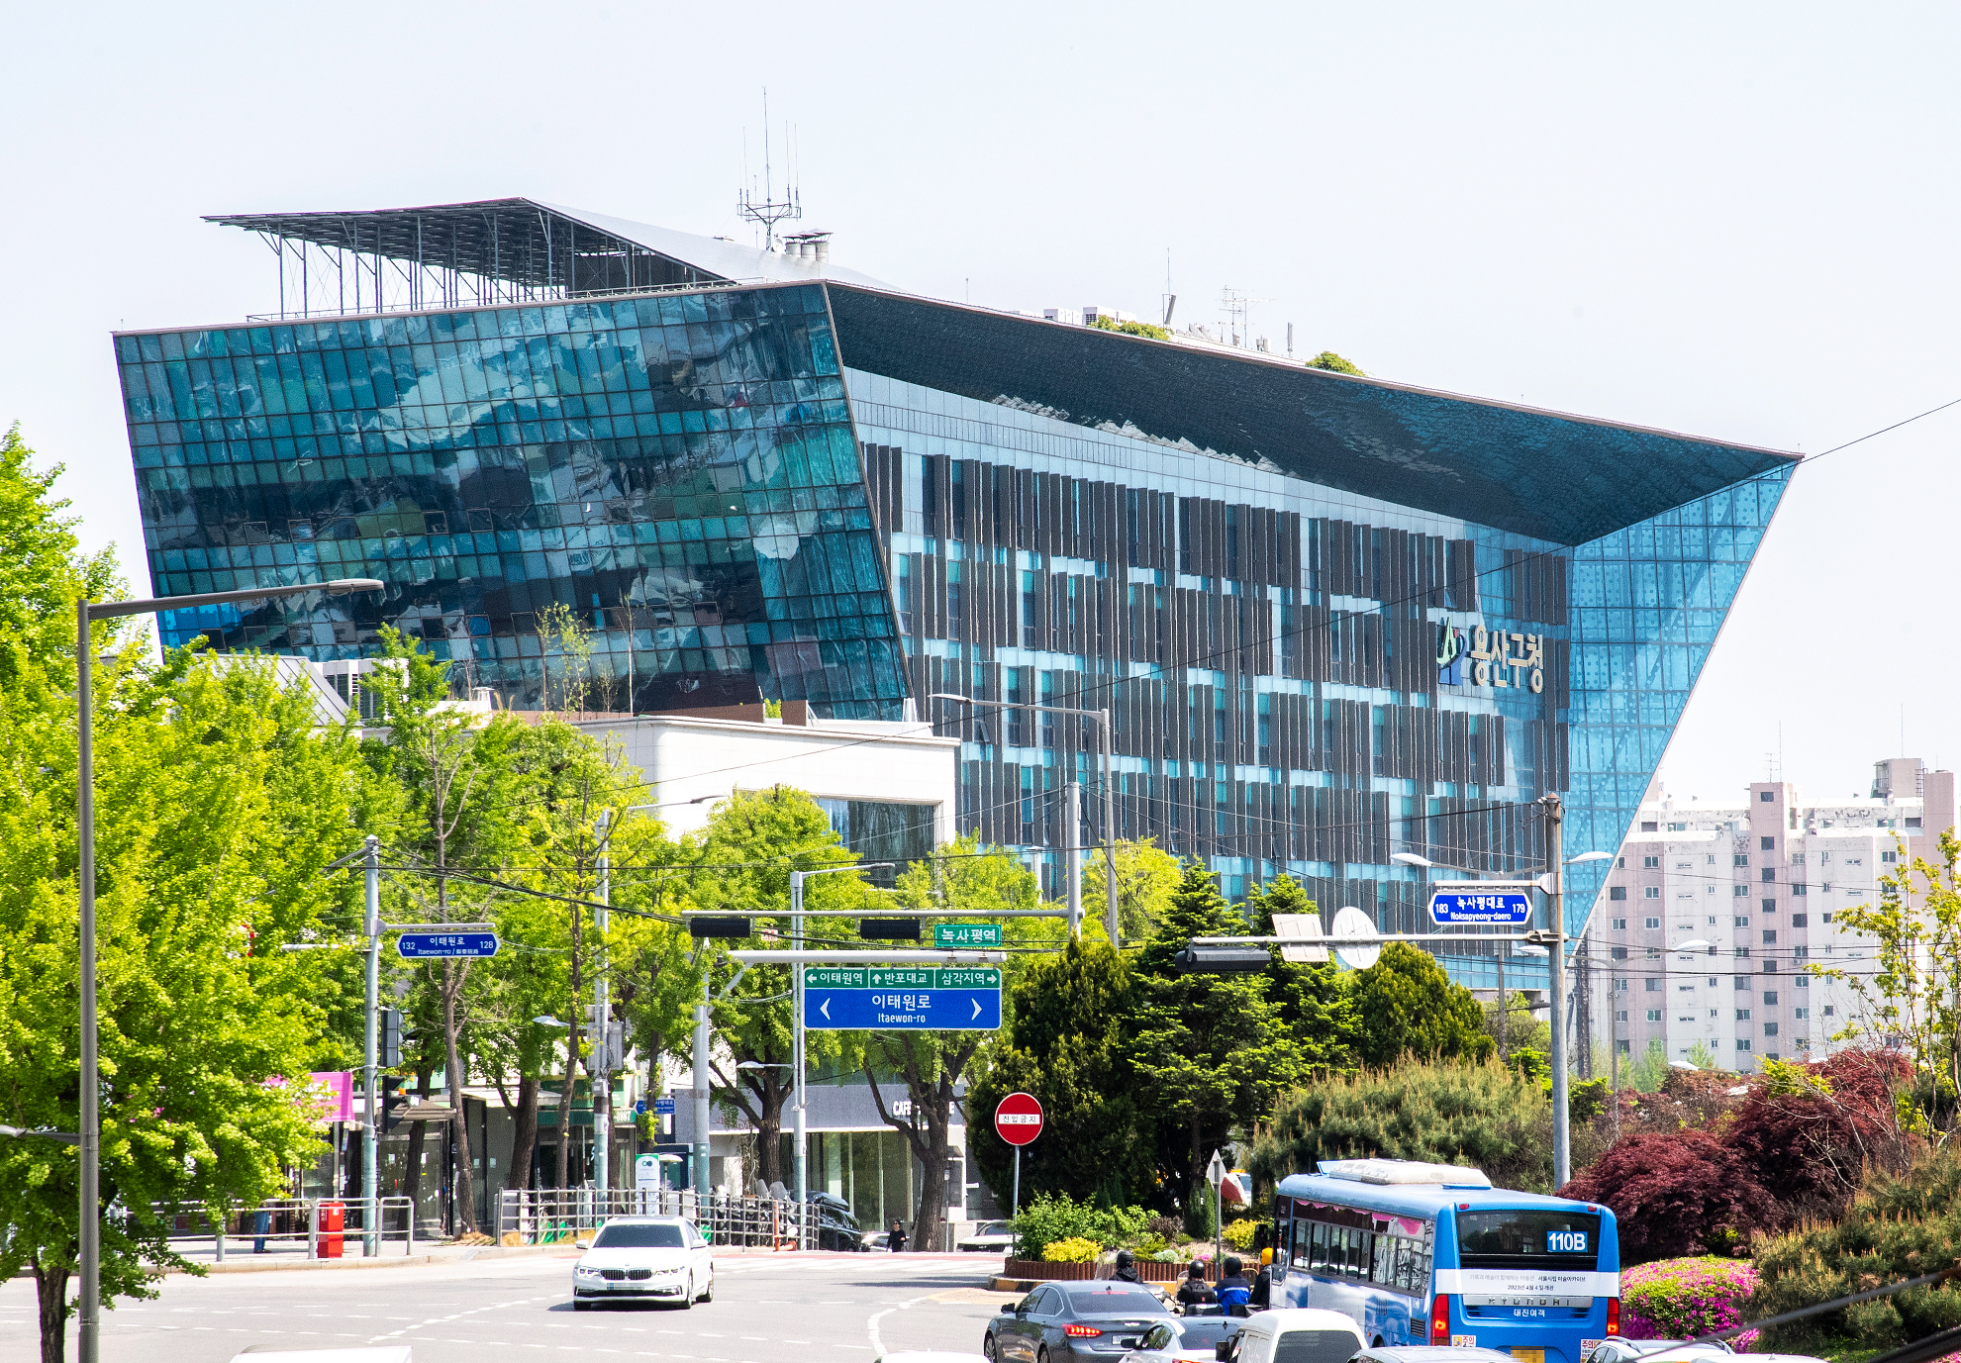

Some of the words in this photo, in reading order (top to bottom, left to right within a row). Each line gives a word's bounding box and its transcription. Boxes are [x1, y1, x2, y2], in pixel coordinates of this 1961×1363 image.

[1470, 624, 1544, 694] 용산구청
[1456, 895, 1505, 910] 녹사평대로
[1435, 903, 1449, 914] 183
[1512, 903, 1525, 914] 179
[1450, 911, 1512, 922] Noksapyeong-daero
[429, 936, 465, 946] 이태원로
[941, 928, 996, 944] 녹사평역
[402, 942, 416, 950] 132
[480, 941, 494, 949] 128
[819, 972, 863, 985] 이태원역
[884, 972, 928, 985] 반포대교
[941, 972, 985, 985] 삼각지역
[871, 994, 932, 1011] 이태원로
[877, 1012, 926, 1023] Itaewon-ro
[1002, 1115, 1037, 1124] 진입금지
[1548, 1232, 1586, 1251] 110B
[1513, 1308, 1546, 1317] 대진여객
[1462, 1335, 1475, 1344] 주의
[1582, 1339, 1594, 1348] 주의
